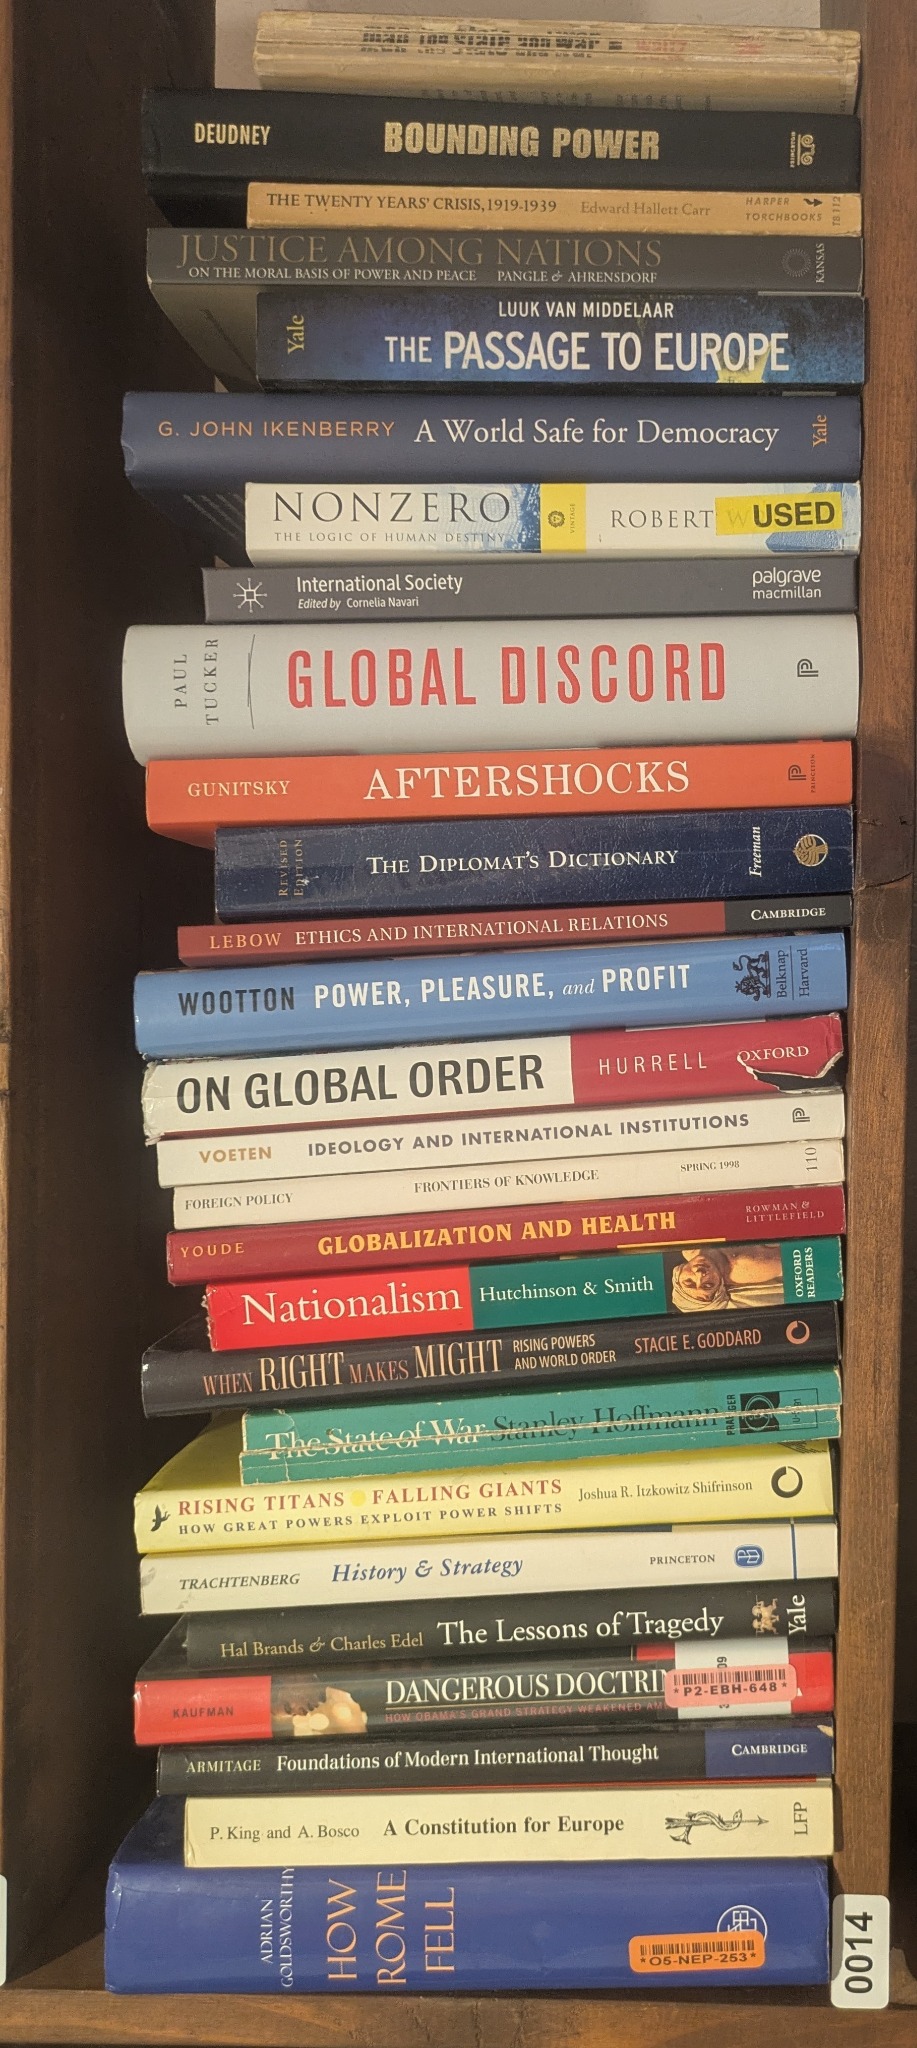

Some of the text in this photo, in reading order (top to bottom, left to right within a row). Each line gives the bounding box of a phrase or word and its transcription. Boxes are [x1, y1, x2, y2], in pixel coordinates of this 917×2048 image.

[194, 122, 271, 145] DEUDNEY
[384, 121, 660, 160] BOUNDING POWER
[304, 194, 373, 208] TWENTY
[377, 196, 429, 209] YEARS'
[581, 202, 711, 216] Edward Hallett Carr
[746, 197, 790, 206] HARPER
[745, 212, 822, 222] TORCHBOOKS
[177, 235, 661, 268] JUSTICE AMONG NATIONS
[815, 242, 825, 284] KANSAS
[245, 267, 477, 282] MORAL BASIS POWER PEACE
[497, 270, 658, 283] PANGLE AHRENSDORF
[499, 301, 674, 318] LUUK MIDDELAAR
[287, 314, 305, 355] Yale
[444, 331, 790, 372] PASSAGE EUROPE
[190, 421, 395, 437] JOHN IKENBERRY
[442, 418, 780, 452] World Safe Democracy
[812, 415, 828, 447] Yale
[273, 491, 511, 524] NONZERO
[610, 509, 714, 529] ROBERT
[753, 501, 835, 528] USED
[310, 532, 506, 543] LOGIC HUMAN DESTINY
[297, 574, 463, 594] International Society
[752, 567, 821, 588] palgrave
[298, 597, 419, 609] Edited Cornelia Navari
[752, 586, 822, 600] macmillan
[174, 654, 188, 708] PAUL
[204, 639, 219, 725] TUCKER
[287, 642, 725, 708] GLOBAL DISCORD
[187, 780, 290, 798] GUNITSKY
[363, 761, 690, 800] AFTERSHOCKS
[548, 850, 679, 869] DICTIONARY
[749, 825, 762, 877] Freeman
[278, 839, 288, 897] REVISED
[750, 906, 826, 921] CAMBRIDGE
[209, 932, 282, 950] LEBOW
[295, 913, 668, 945] ETHICS INTERNATIONAL RELATIONS
[776, 950, 788, 999] Belknap
[799, 948, 810, 997] Harvard
[314, 964, 690, 1009] POWER, PLEASURE, PROFIT
[178, 987, 295, 1017] WOOTTON
[599, 1051, 708, 1076] HURRELL
[738, 1045, 809, 1063] OXFORD
[244, 1054, 545, 1109] GLOBAL ORDER
[308, 1114, 749, 1157] IDEOLOGY INTERNATIONAL INSTITUTIONS
[199, 1146, 272, 1163] VOETEN
[680, 1160, 740, 1173] SPRING 1998
[806, 1146, 818, 1172] 110
[414, 1169, 599, 1193] FRONTIERS KNOWLEDGE
[185, 1193, 293, 1210] FOREIGN POLICY
[745, 1202, 798, 1213] ROWMAN
[745, 1210, 825, 1223] LITTLEFIELD
[317, 1211, 676, 1256] GLOBALIZATION HEALTH
[180, 1242, 245, 1258] YOUDE
[806, 1246, 816, 1298] READERS
[479, 1277, 653, 1303] Hutchinson Smith
[241, 1282, 464, 1326] Nationalism
[513, 1334, 596, 1353] RISING POWERS
[634, 1329, 762, 1354] STACIE GODDARD
[204, 1339, 502, 1396] WHEN RIGHT MAKES MIGHT
[539, 1351, 616, 1368] WORLD ORDER
[372, 1479, 562, 1504] FALLING GIANTS
[579, 1480, 753, 1502] Joshua Itzkowitz Shifrinson
[179, 1492, 345, 1516] RISING TITANS
[224, 1502, 562, 1533] GREAT POWERS EXPLOIT POWER SHIFTS
[332, 1556, 523, 1585] History Strategy
[649, 1554, 715, 1565] PRINCETON
[179, 1574, 301, 1590] TRACHTENBERG
[496, 1608, 724, 1642] Lessons Tragedy
[786, 1594, 806, 1635] Yale
[253, 1635, 386, 1656] Brands Charles
[386, 1672, 549, 1704] DANGEROUS
[172, 1706, 234, 1719] KAUFMAN
[277, 1744, 659, 1771] Foundations Modern International Thought
[731, 1742, 808, 1756] CAMBRIDGE
[186, 1759, 261, 1773] ARMITAGE
[405, 1815, 624, 1835] Constitution Europe
[794, 1802, 808, 1835] LFP
[227, 1825, 360, 1841] King Bosco
[260, 1899, 273, 1964] ADRIAN
[281, 1866, 295, 1988] GOLDSWORTHY
[327, 1878, 357, 1980] HOW
[376, 1869, 407, 1985] ROME
[424, 1887, 455, 1973] FELL
[844, 1911, 873, 1994] 0014
